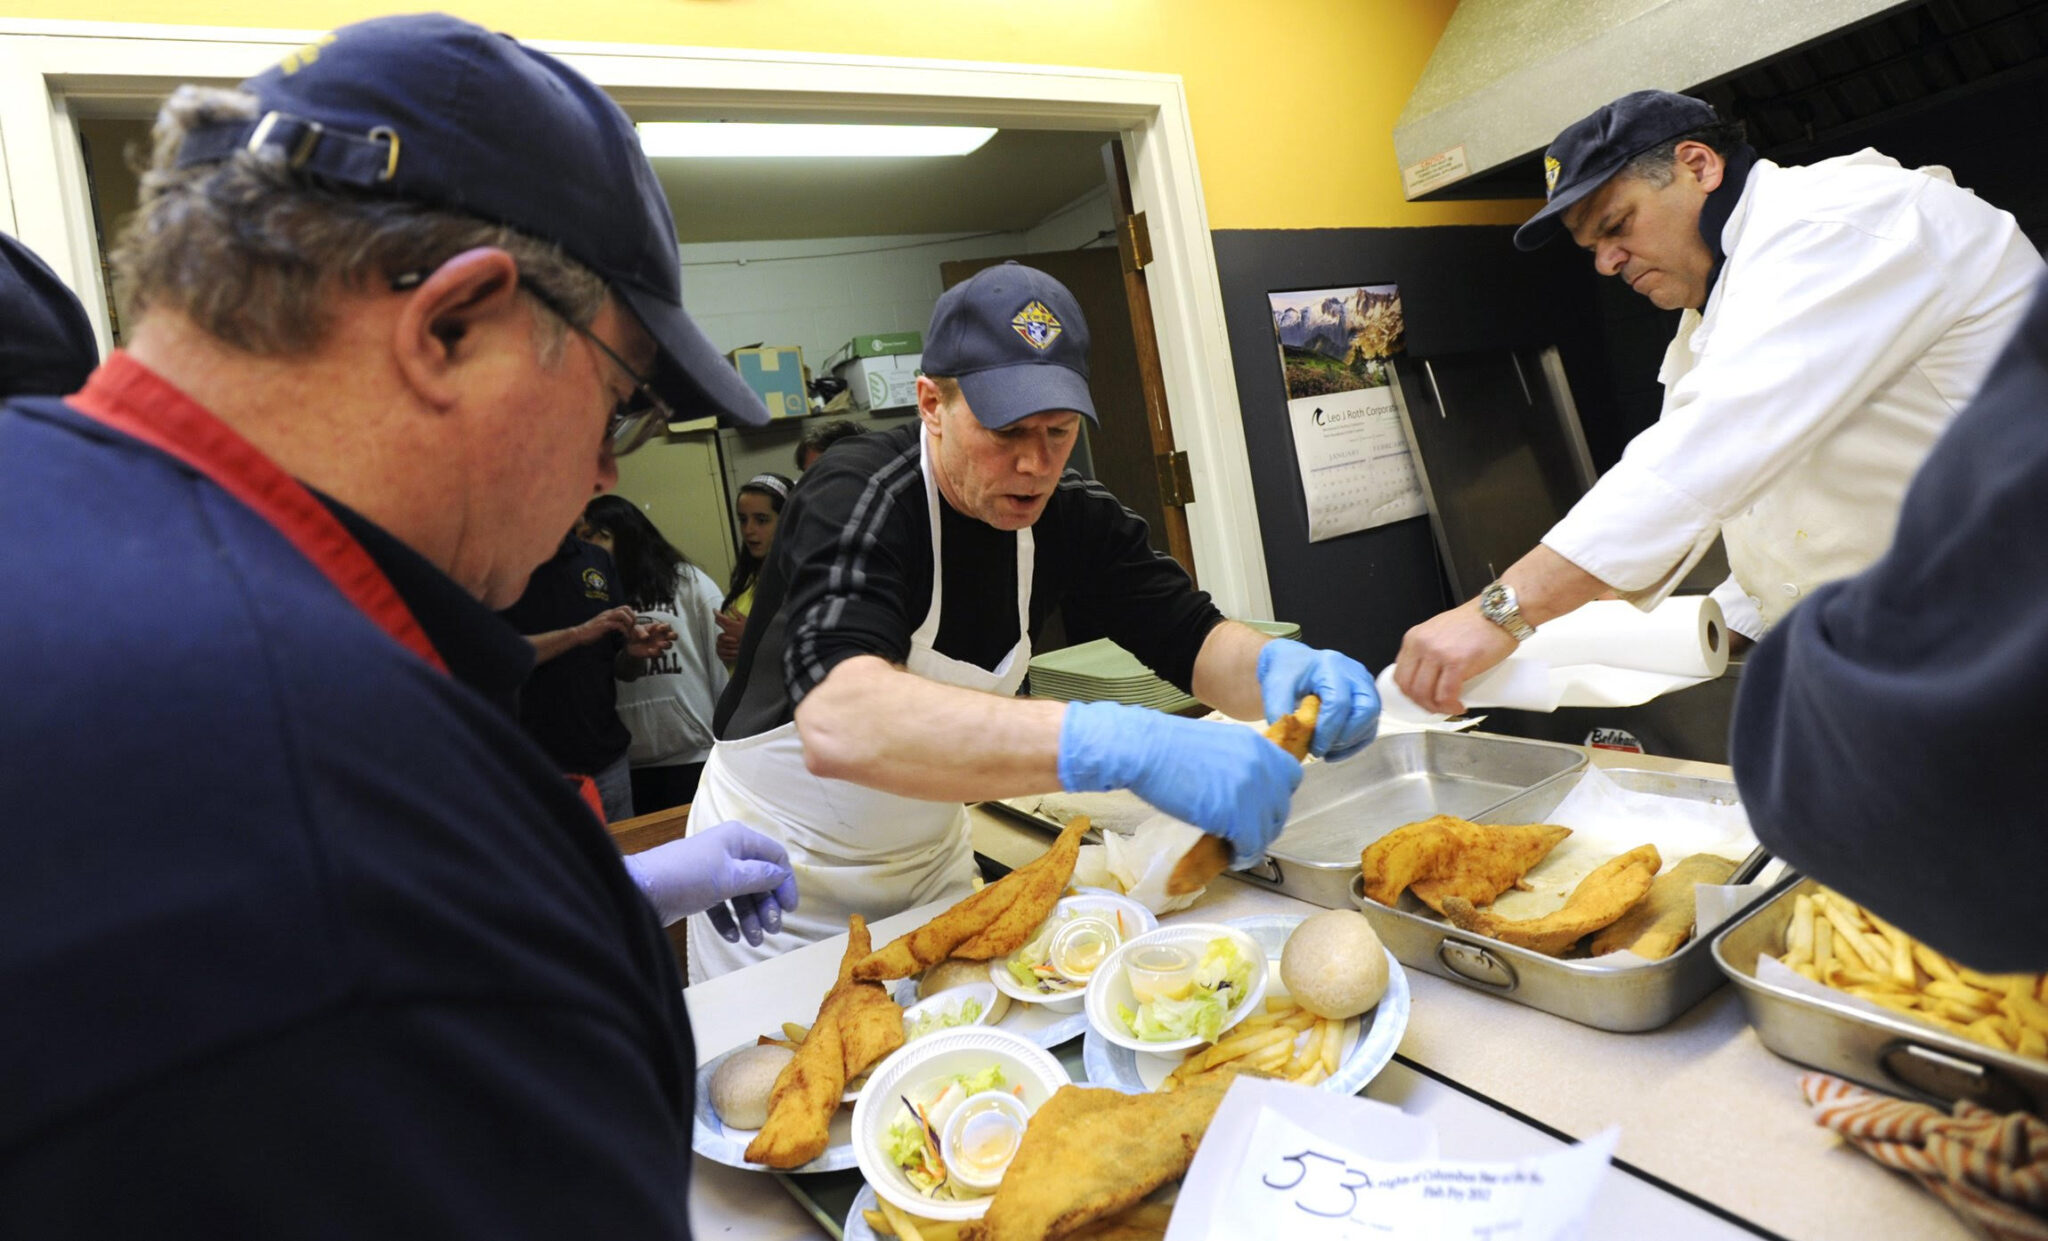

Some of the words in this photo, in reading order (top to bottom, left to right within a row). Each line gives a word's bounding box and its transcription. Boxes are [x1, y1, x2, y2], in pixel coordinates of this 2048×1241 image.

[1327, 413, 1341, 423] Leo
[1342, 412, 1346, 421] J
[1347, 408, 1366, 419] Roth
[1365, 404, 1399, 417] Corporat
[1262, 1150, 1373, 1218] 53
